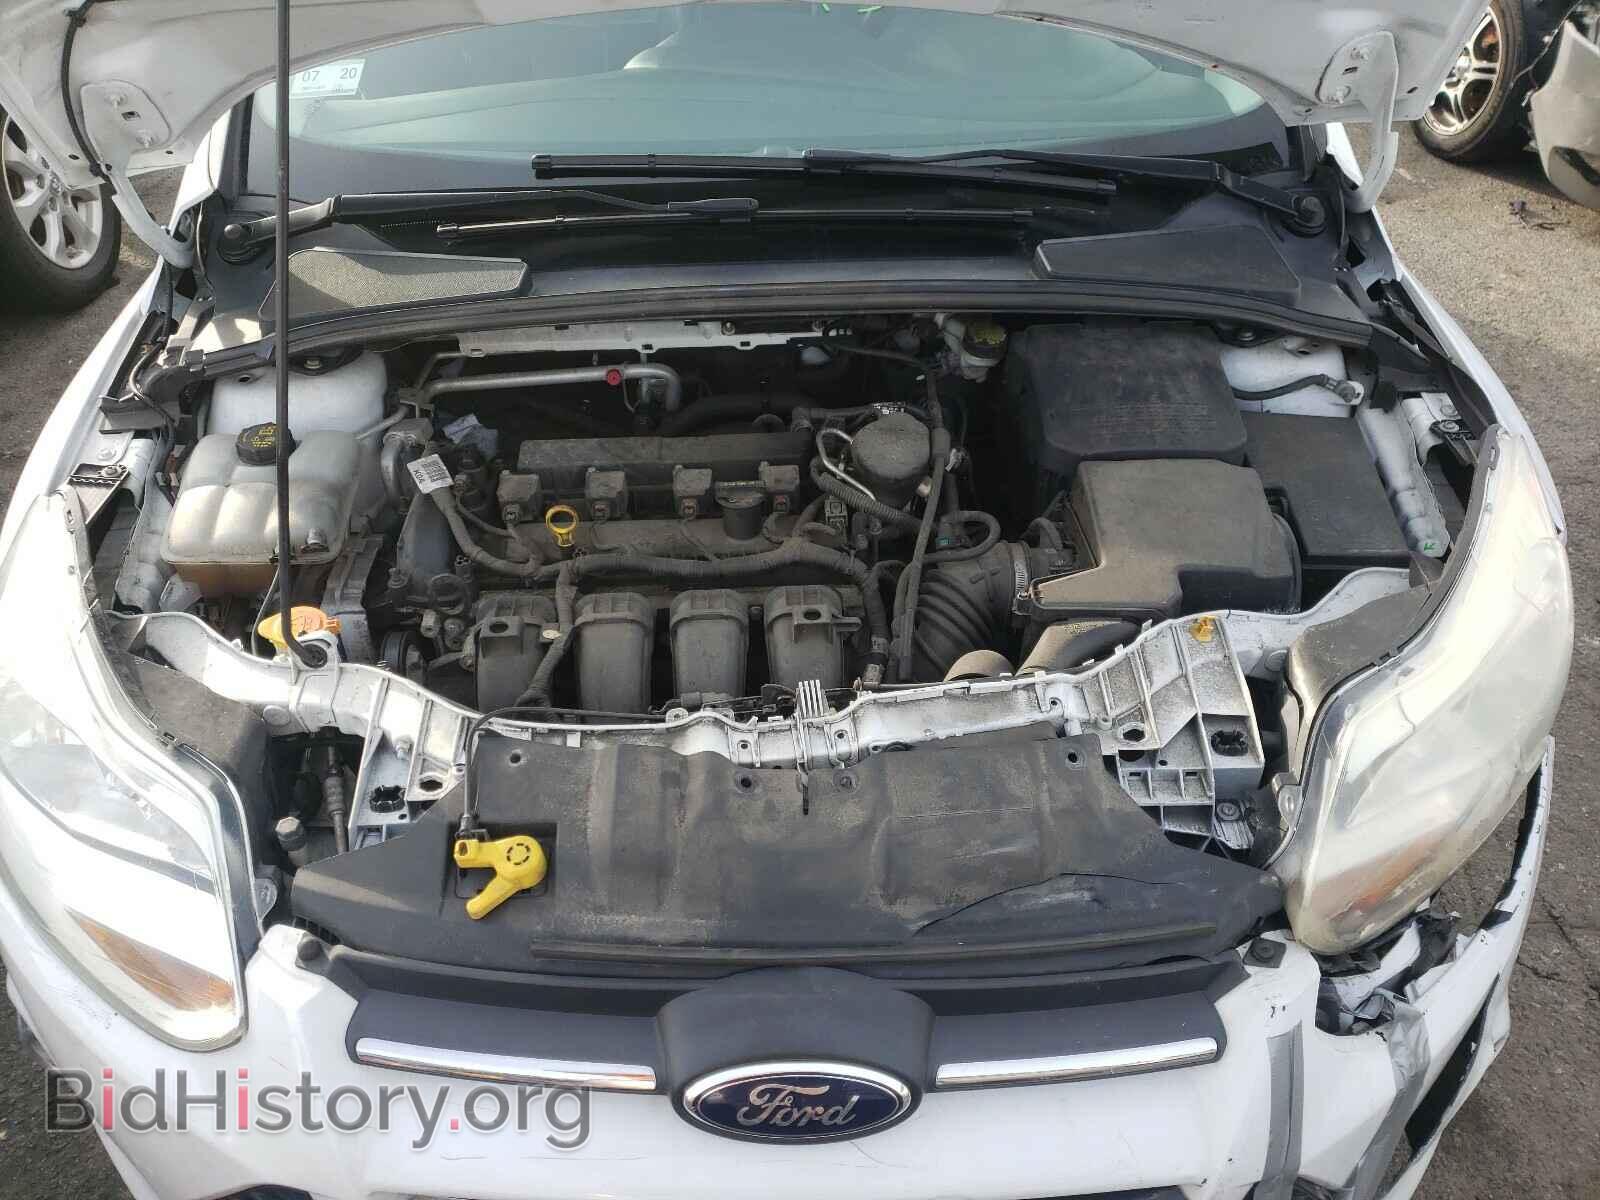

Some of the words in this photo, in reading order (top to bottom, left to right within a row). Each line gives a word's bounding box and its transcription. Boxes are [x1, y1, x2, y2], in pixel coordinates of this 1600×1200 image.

[303, 70, 320, 81] 07
[340, 67, 358, 79] 20
[736, 1083, 860, 1127] Ford
